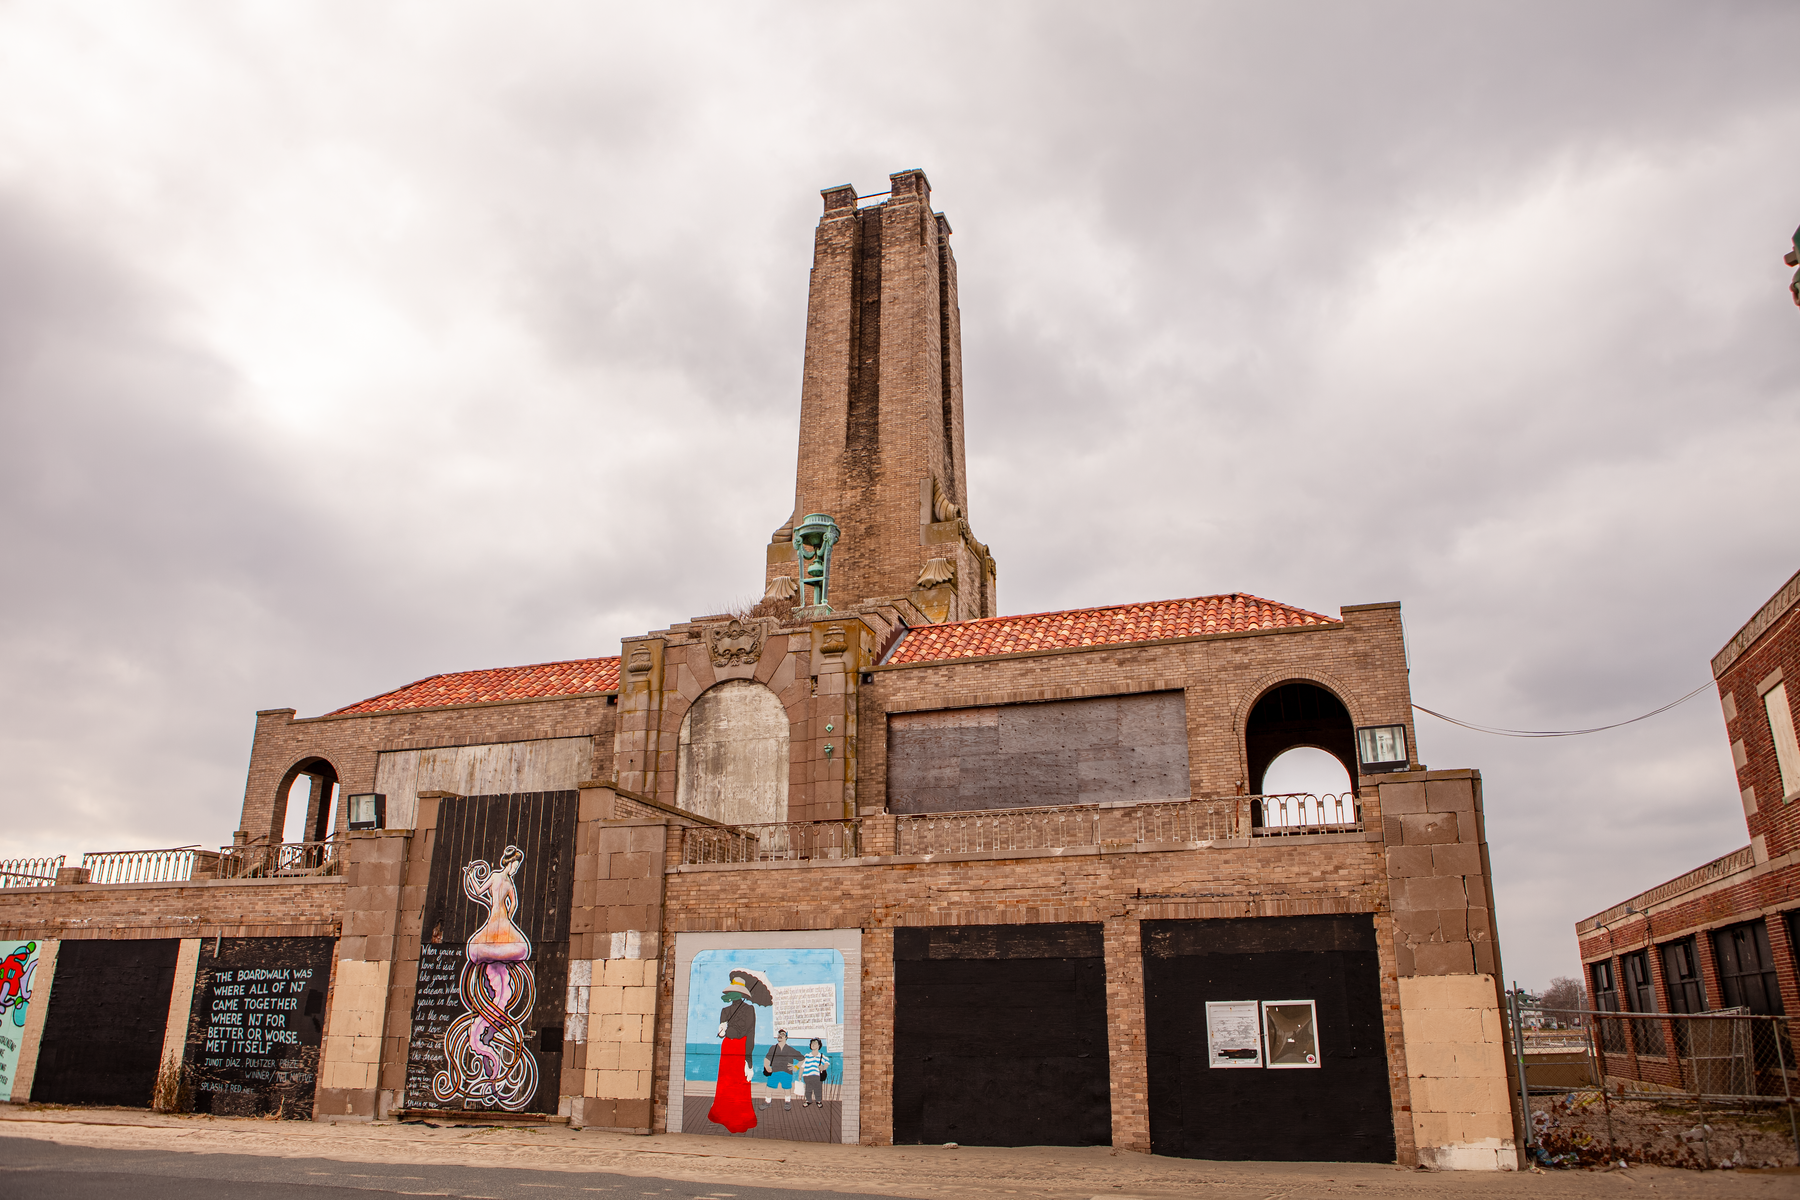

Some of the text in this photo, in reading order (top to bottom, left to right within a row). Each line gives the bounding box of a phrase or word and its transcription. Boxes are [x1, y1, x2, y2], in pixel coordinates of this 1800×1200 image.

[421, 944, 437, 956] When
[421, 958, 434, 969] love
[215, 968, 313, 982] THE BOARDWALK WAS
[213, 981, 306, 996] WHERE ALL OF NJ
[212, 998, 297, 1010] CAME TOGETHER
[211, 1013, 286, 1028] WHERE NJ FOR
[207, 1026, 302, 1045] BETTER OR WORSE,
[205, 1040, 273, 1055] MET ITSELF
[204, 1058, 224, 1067] JUNOT
[200, 1082, 223, 1092] SPLASH
